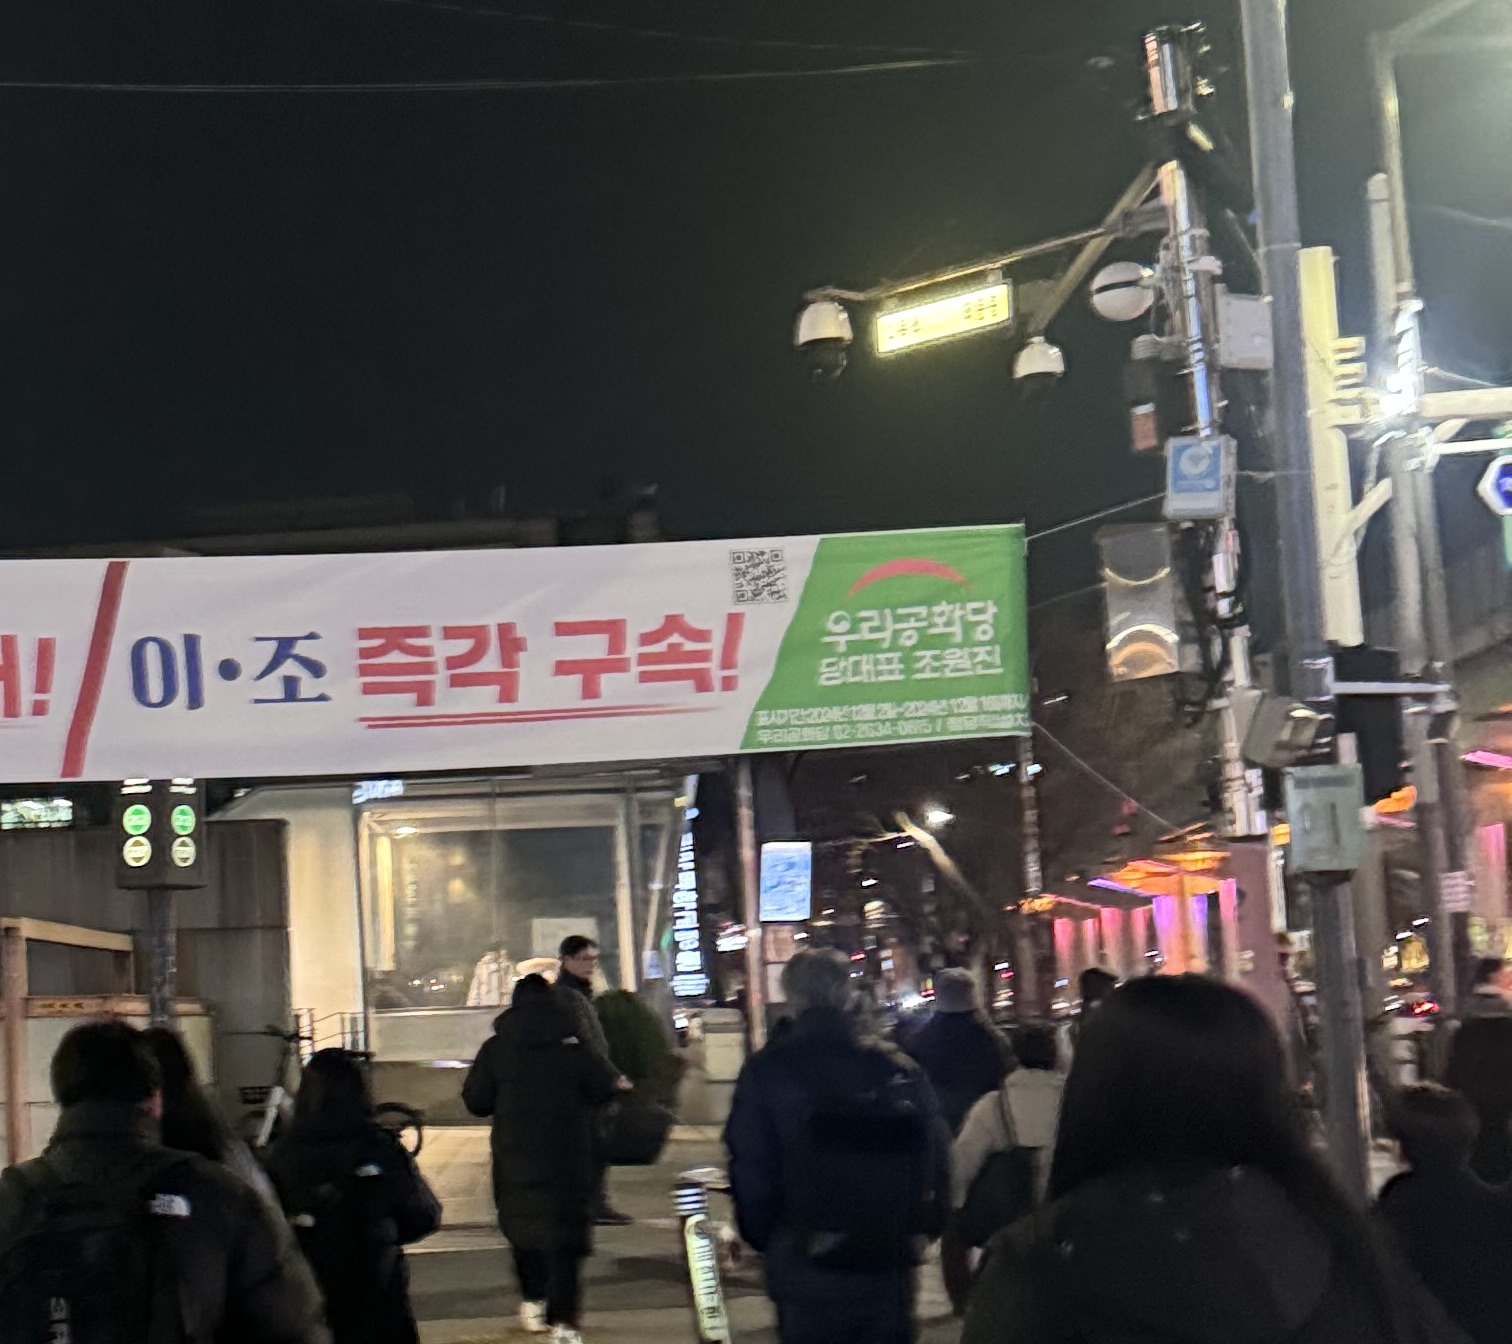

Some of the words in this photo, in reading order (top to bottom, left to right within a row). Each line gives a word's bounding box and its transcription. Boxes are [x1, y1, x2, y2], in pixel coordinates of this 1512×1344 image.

[820, 599, 999, 653] 우리공화당
[355, 621, 527, 707] 즉각
[550, 611, 745, 700] 구속!
[817, 651, 906, 687] 당대표
[912, 644, 1005, 680] 조원진
